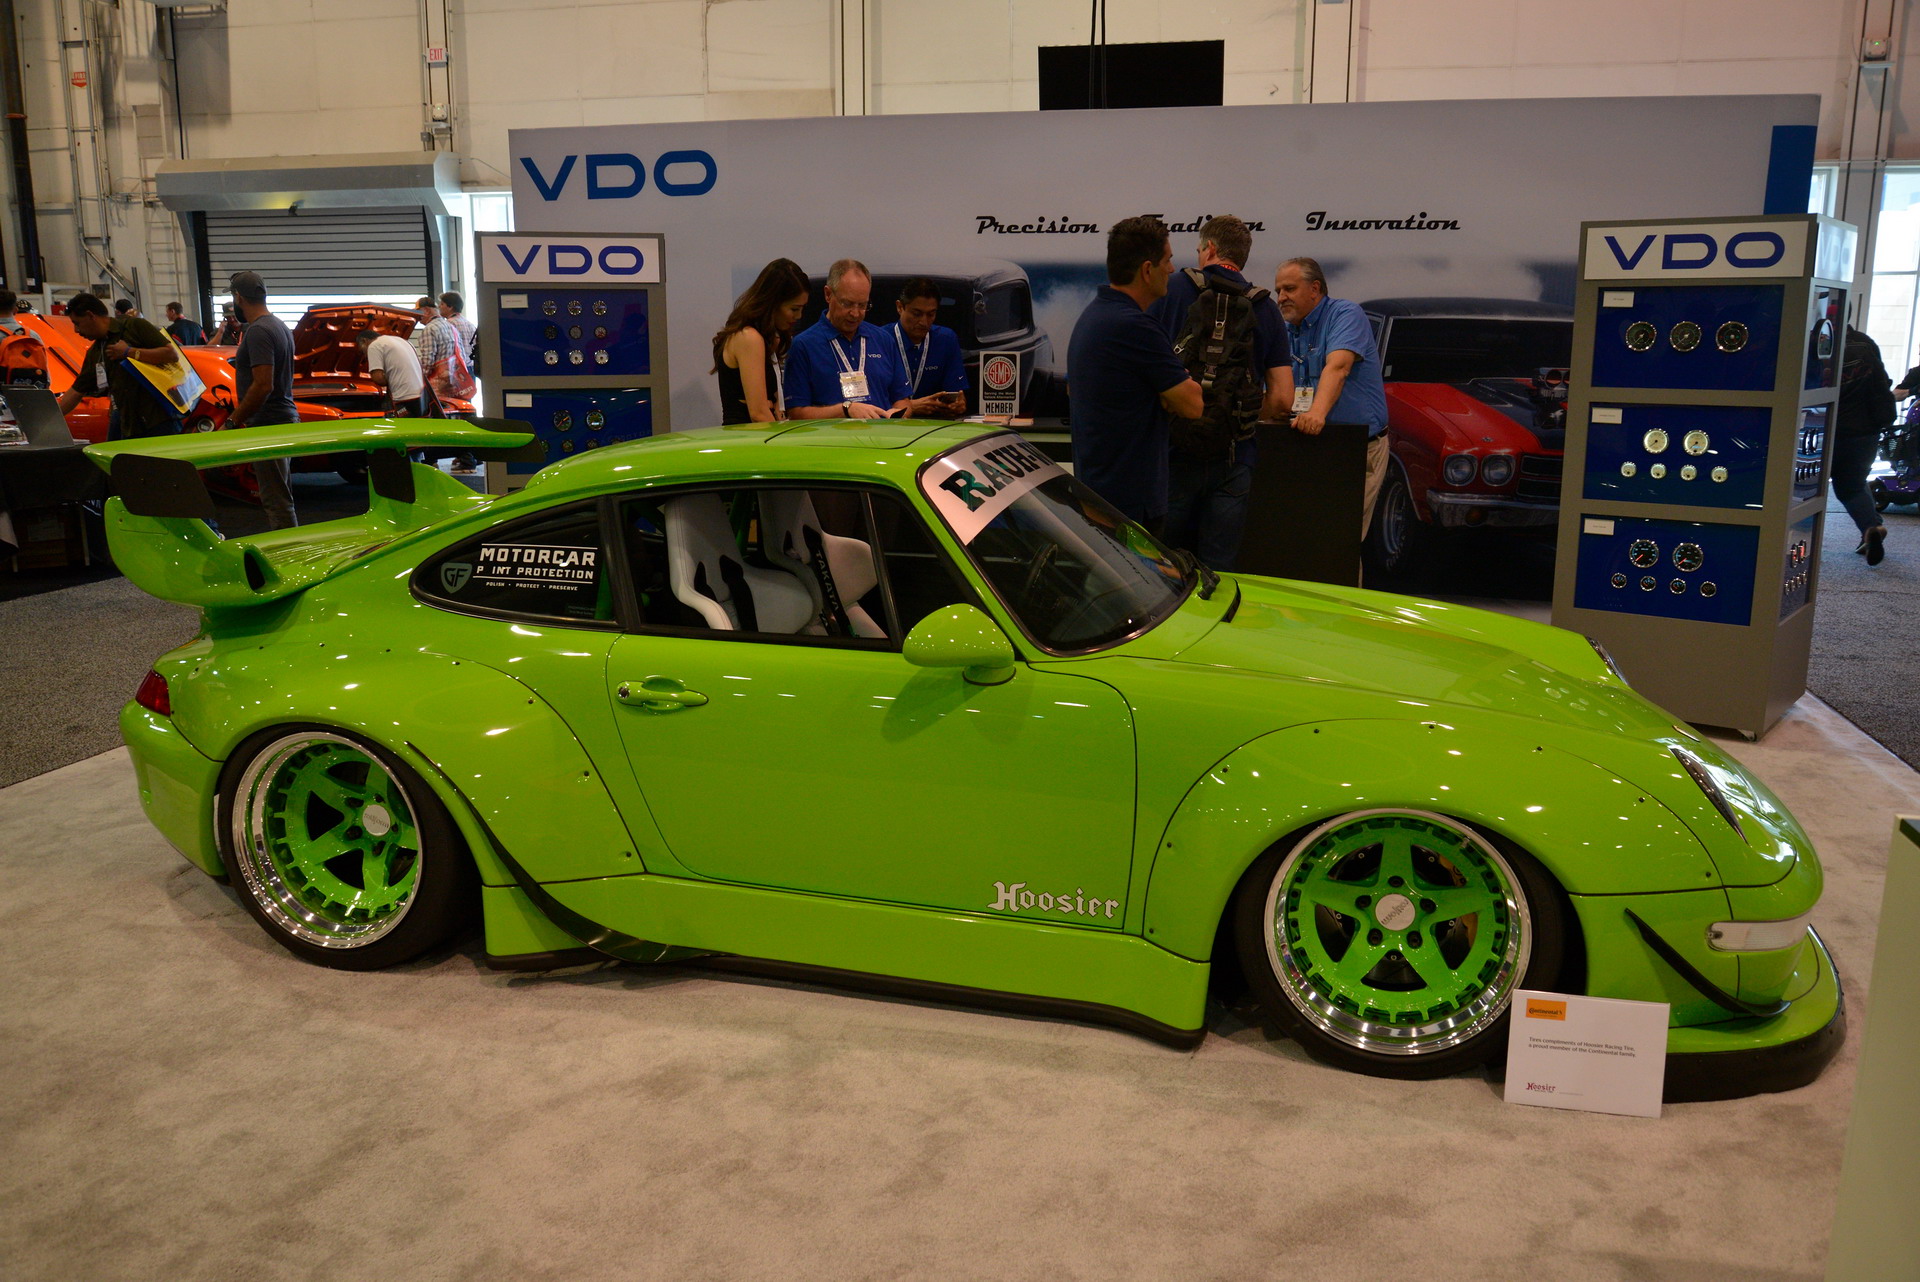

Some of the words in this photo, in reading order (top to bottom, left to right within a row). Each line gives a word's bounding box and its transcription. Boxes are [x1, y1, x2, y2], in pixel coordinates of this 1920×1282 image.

[430, 48, 443, 60] EXIT
[520, 150, 718, 202] VDO
[976, 216, 1100, 234] Precision
[1306, 211, 1461, 231] Innovation
[496, 244, 644, 276] VDO
[1604, 232, 1786, 270] VDO
[990, 362, 1010, 384] SEMA
[986, 402, 1013, 413] MEMBER
[479, 548, 595, 566] MOTORCAR
[444, 568, 469, 587] GF
[516, 567, 594, 580] PROTECTION
[816, 550, 839, 610] TAKATA
[986, 881, 1120, 919] Hoosier
[1526, 1082, 1556, 1092] Hoosier
